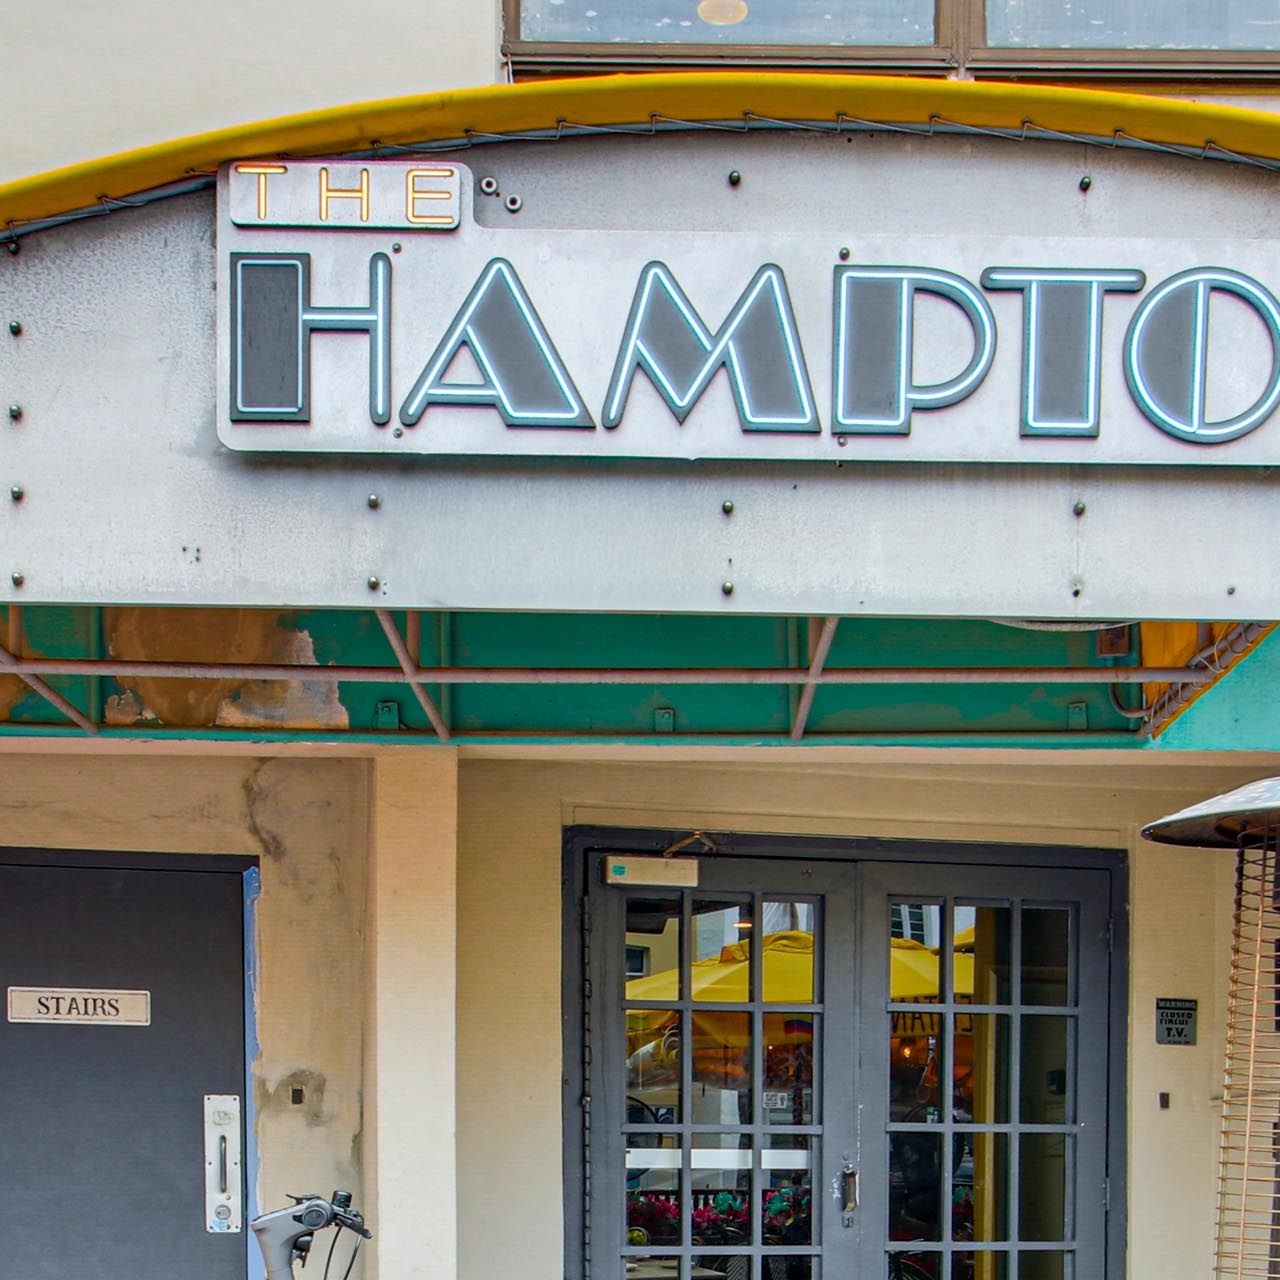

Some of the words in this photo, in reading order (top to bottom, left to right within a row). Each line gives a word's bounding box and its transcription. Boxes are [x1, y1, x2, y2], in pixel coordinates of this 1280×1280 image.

[235, 163, 455, 225] THE
[37, 996, 120, 1017] STAIRS
[1166, 1027, 1187, 1038] T.V.
